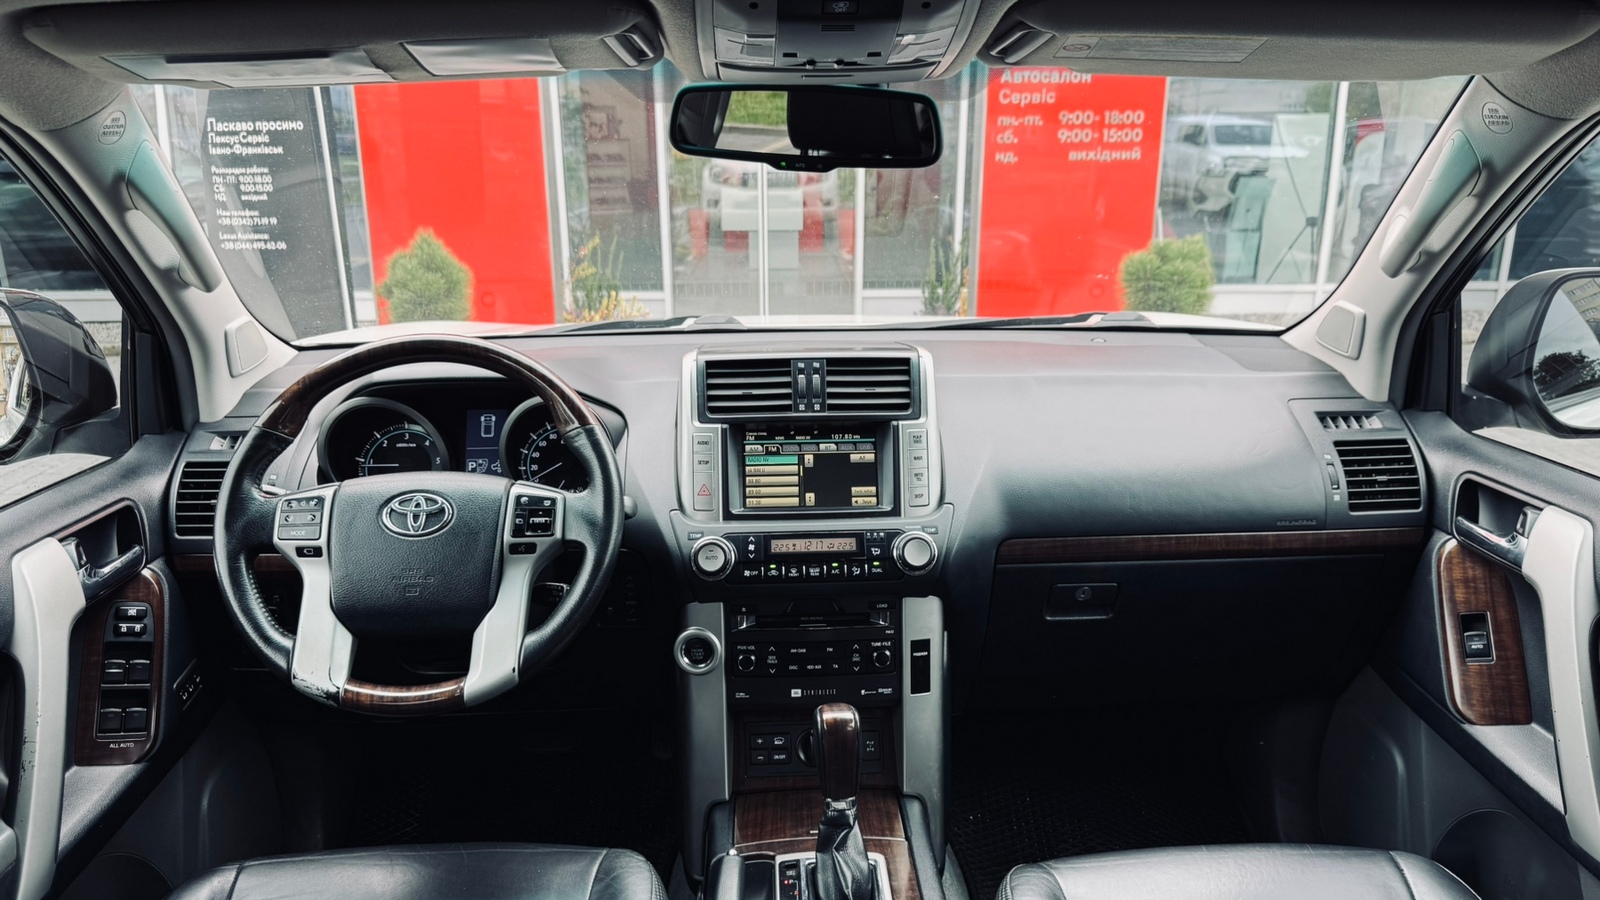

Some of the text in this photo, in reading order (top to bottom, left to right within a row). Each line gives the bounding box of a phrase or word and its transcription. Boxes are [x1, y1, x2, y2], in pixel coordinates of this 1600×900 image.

[1001, 68, 1092, 84] Автосалон
[999, 88, 1056, 107] Сервіс
[1104, 110, 1144, 124] 18:00
[255, 120, 304, 133] просимо
[1102, 128, 1143, 142] 15:00
[208, 144, 284, 156] Івано-Франківськ
[1068, 147, 1141, 162] вихідний
[469, 462, 476, 471] P
